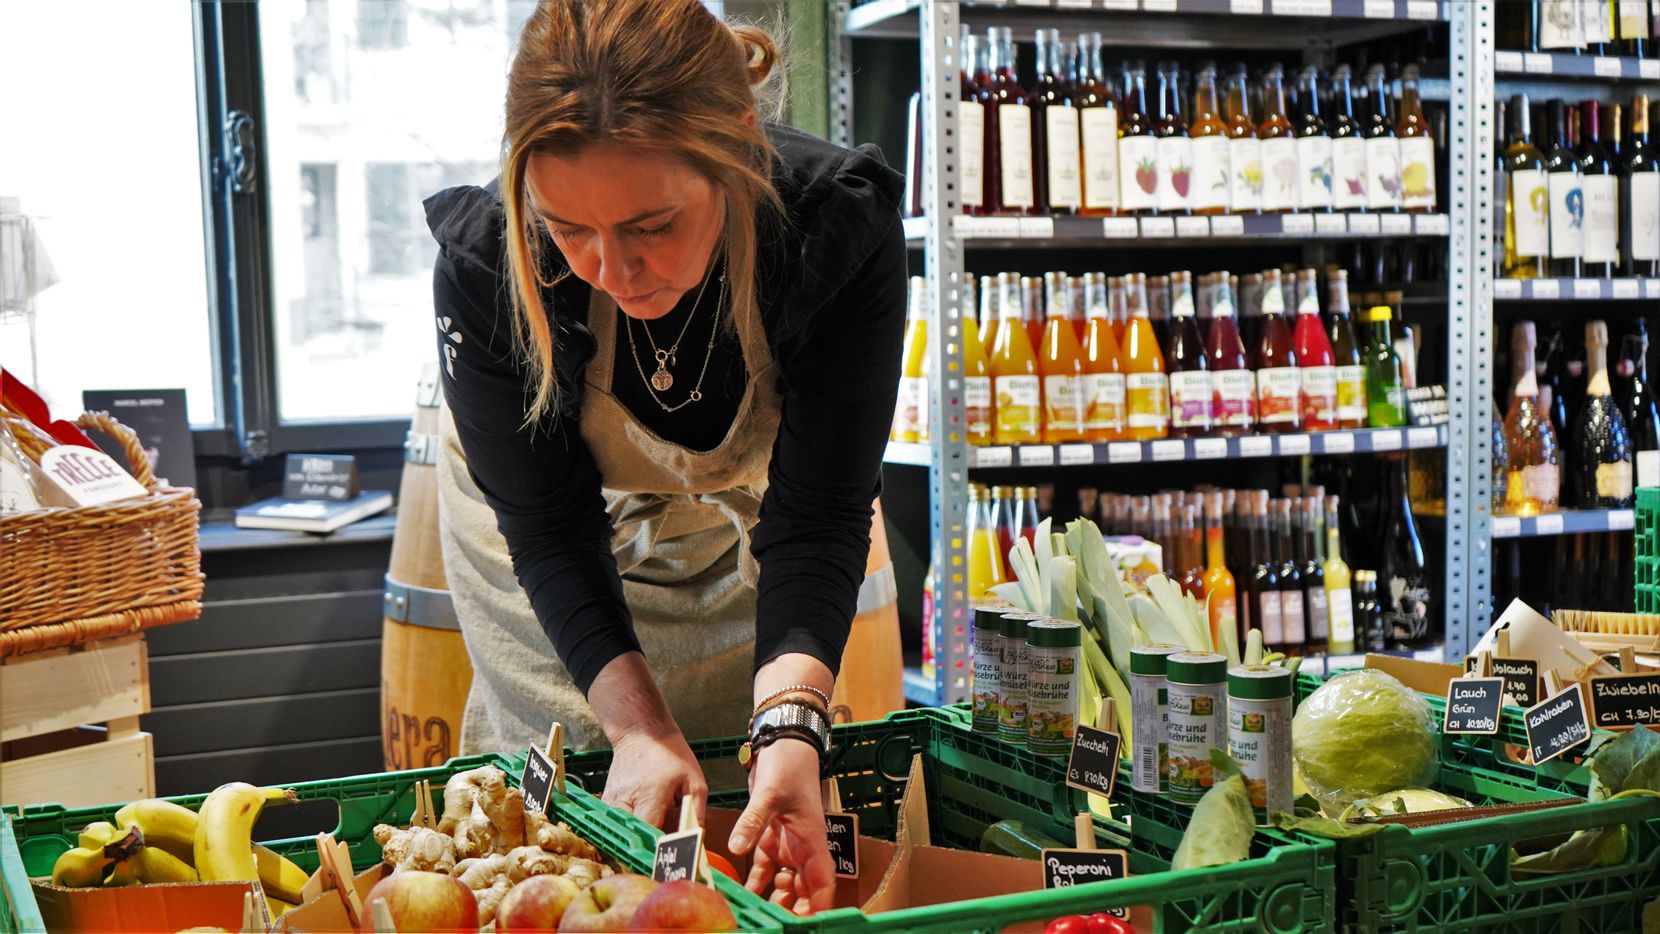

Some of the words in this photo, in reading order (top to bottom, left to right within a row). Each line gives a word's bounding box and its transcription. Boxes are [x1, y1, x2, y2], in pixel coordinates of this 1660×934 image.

[1003, 671, 1027, 680] Würz
[1051, 681, 1070, 690] und
[1455, 687, 1487, 700] Lauch
[1452, 704, 1475, 714] Grün
[1601, 712, 1620, 721] CH
[1186, 723, 1207, 732] und
[1449, 721, 1460, 729] CH
[1077, 733, 1110, 756] Zucchetti
[1238, 741, 1258, 750] und
[1535, 745, 1543, 758] IT
[1047, 857, 1112, 878] Peperoni
